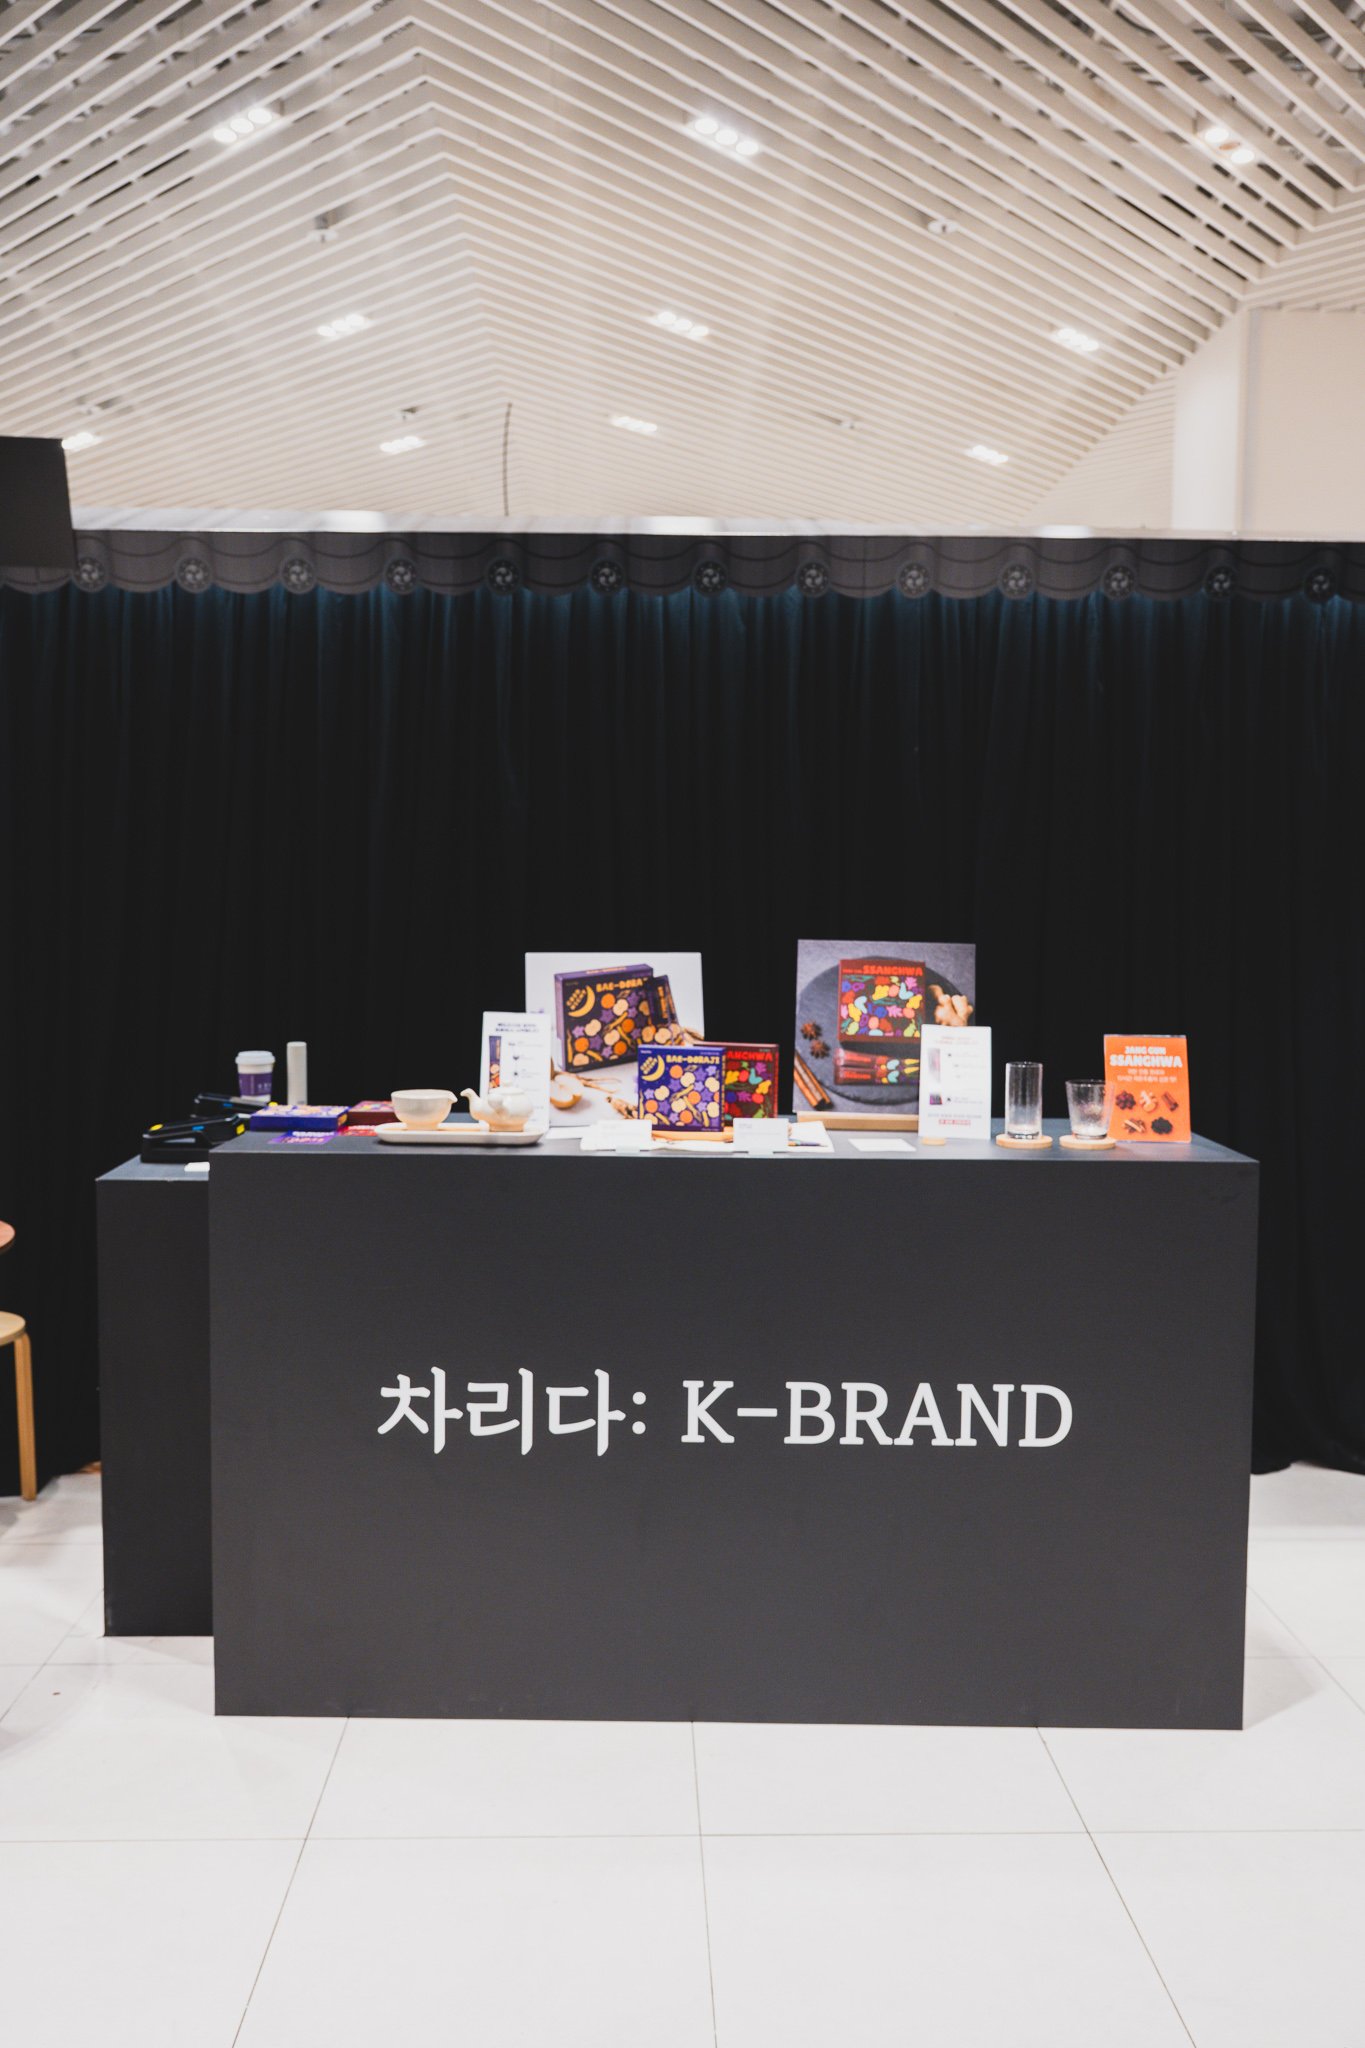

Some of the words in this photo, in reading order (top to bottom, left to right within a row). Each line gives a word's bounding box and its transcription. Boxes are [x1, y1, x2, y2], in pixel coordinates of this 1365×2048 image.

[727, 1051, 774, 1062] ANGHWA
[1110, 1054, 1183, 1068] SSANGHWA
[377, 1366, 647, 1457] 차리다:
[681, 1380, 1073, 1448] K-BRAND
